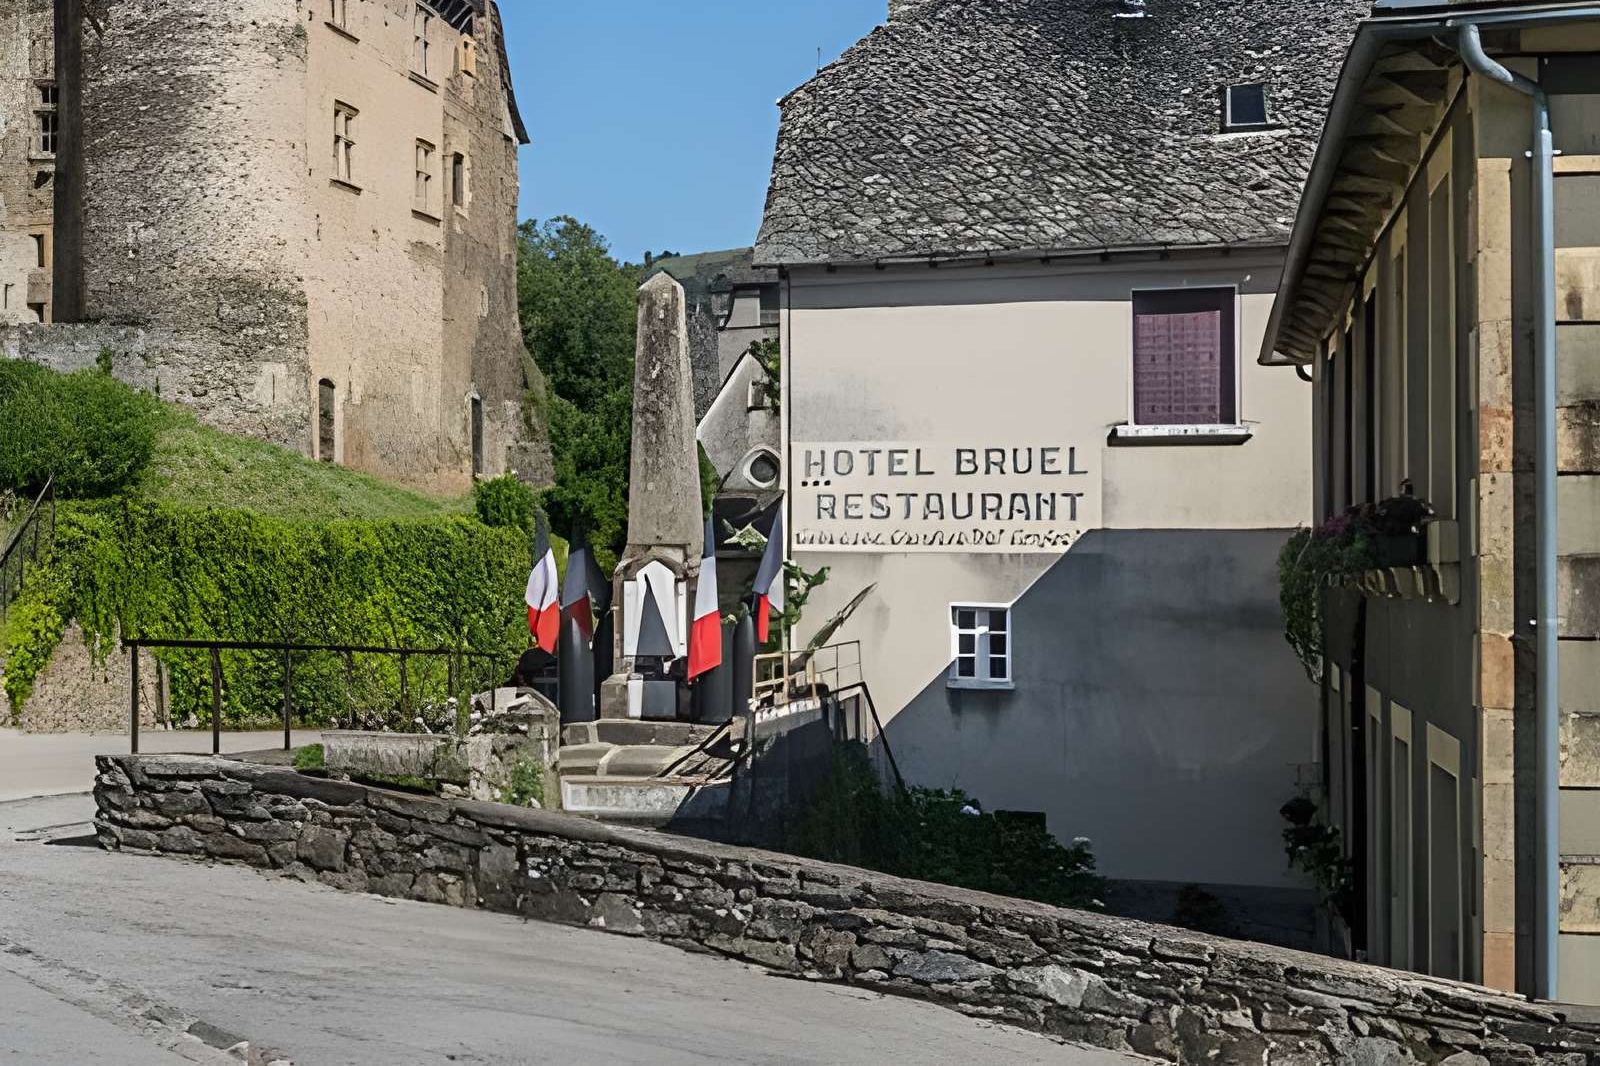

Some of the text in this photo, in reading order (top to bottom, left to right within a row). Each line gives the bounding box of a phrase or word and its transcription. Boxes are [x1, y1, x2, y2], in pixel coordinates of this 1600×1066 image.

[804, 446, 1088, 477] HOTEL BRUEL
[816, 492, 1084, 521] RESTAURANT
